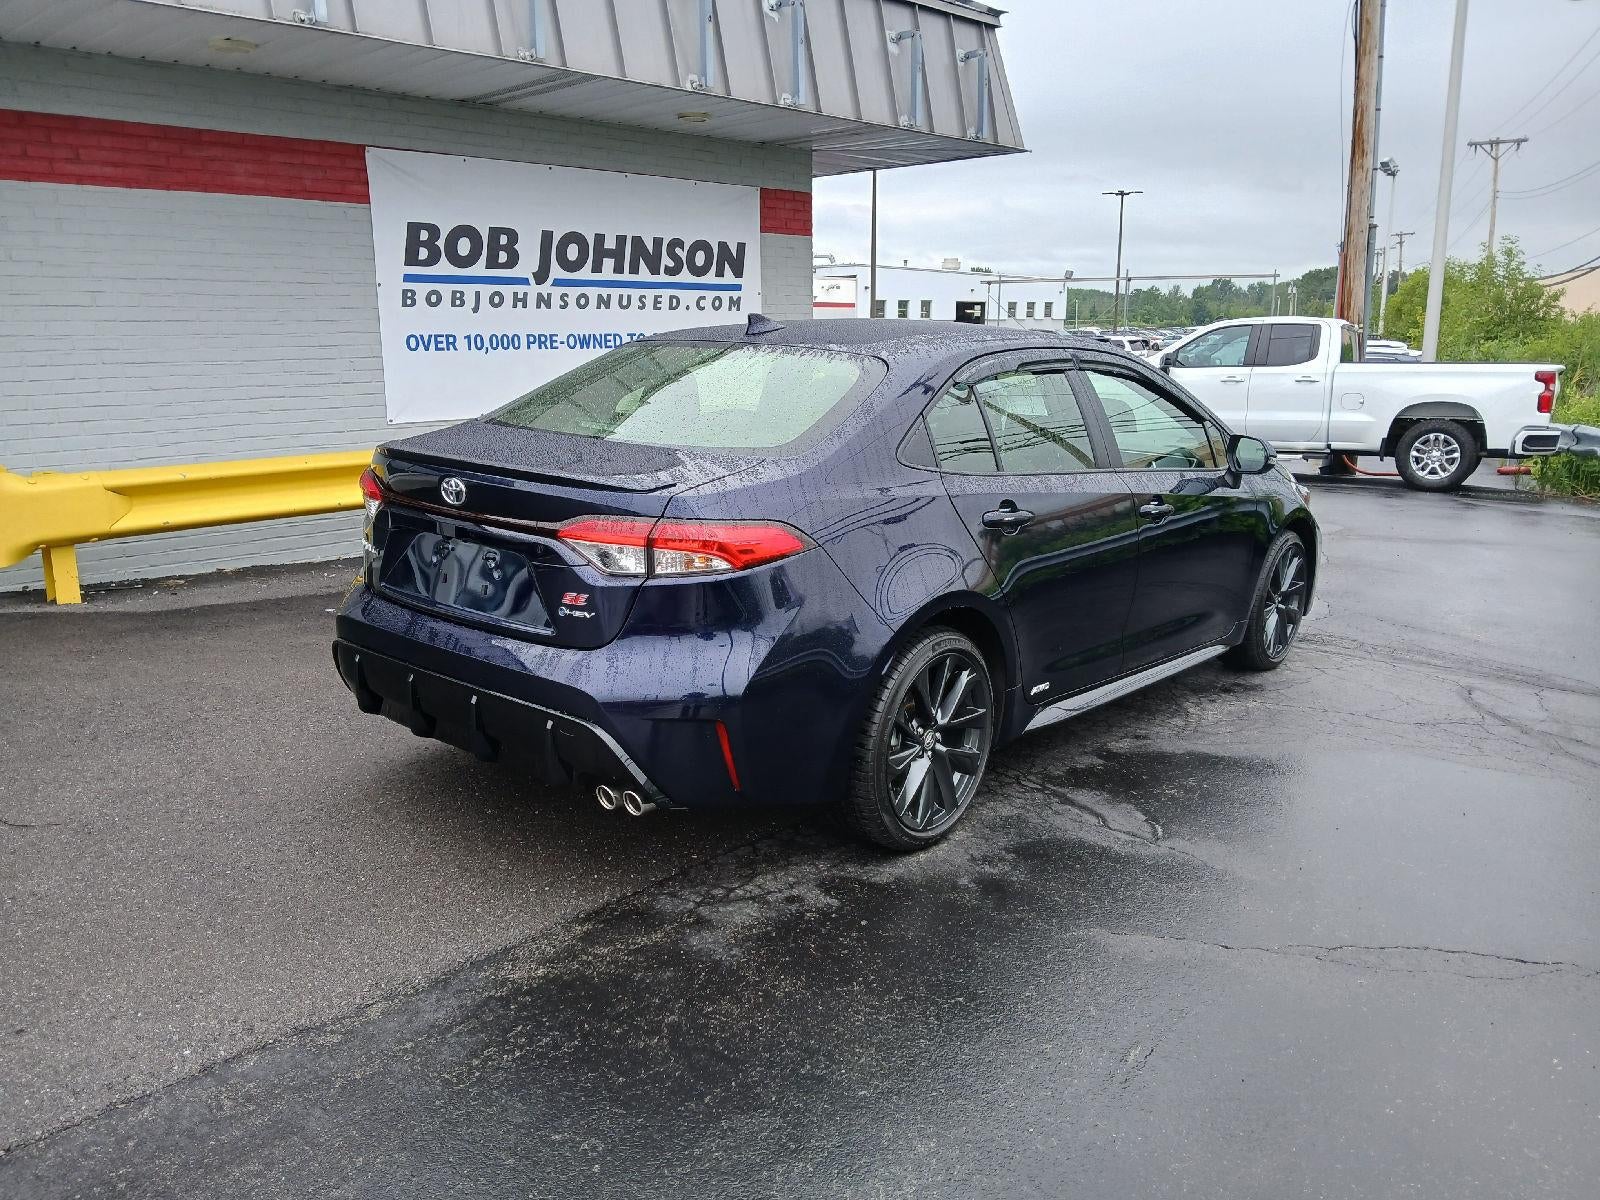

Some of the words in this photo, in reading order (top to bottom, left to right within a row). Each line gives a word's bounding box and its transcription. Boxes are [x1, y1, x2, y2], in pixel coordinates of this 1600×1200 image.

[404, 221, 520, 270] BOB
[532, 229, 746, 286] JOHNSON
[401, 288, 742, 314] BOBJOHNSONUSED.COM
[405, 333, 458, 352] OVER
[463, 333, 521, 355] 10,000
[526, 332, 623, 350] PRE-OWNED
[562, 592, 589, 605] SE
